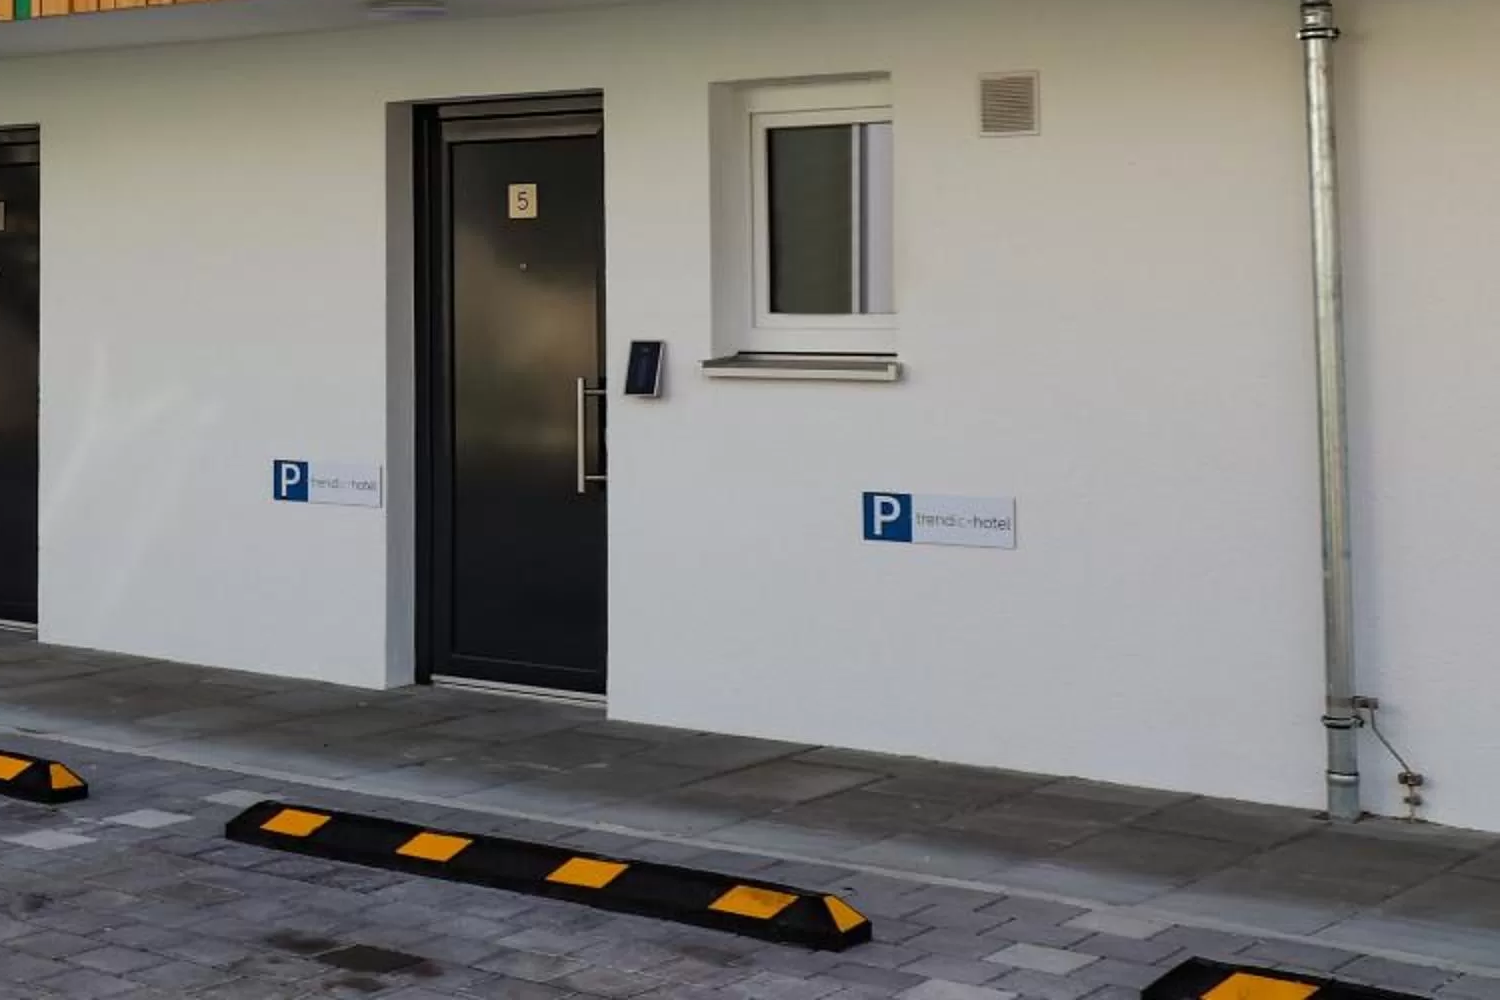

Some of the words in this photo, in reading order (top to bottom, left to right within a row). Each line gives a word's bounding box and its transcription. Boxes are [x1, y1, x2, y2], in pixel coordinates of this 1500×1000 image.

[517, 191, 529, 211] 5
[281, 463, 301, 497] P
[873, 495, 901, 535] P
